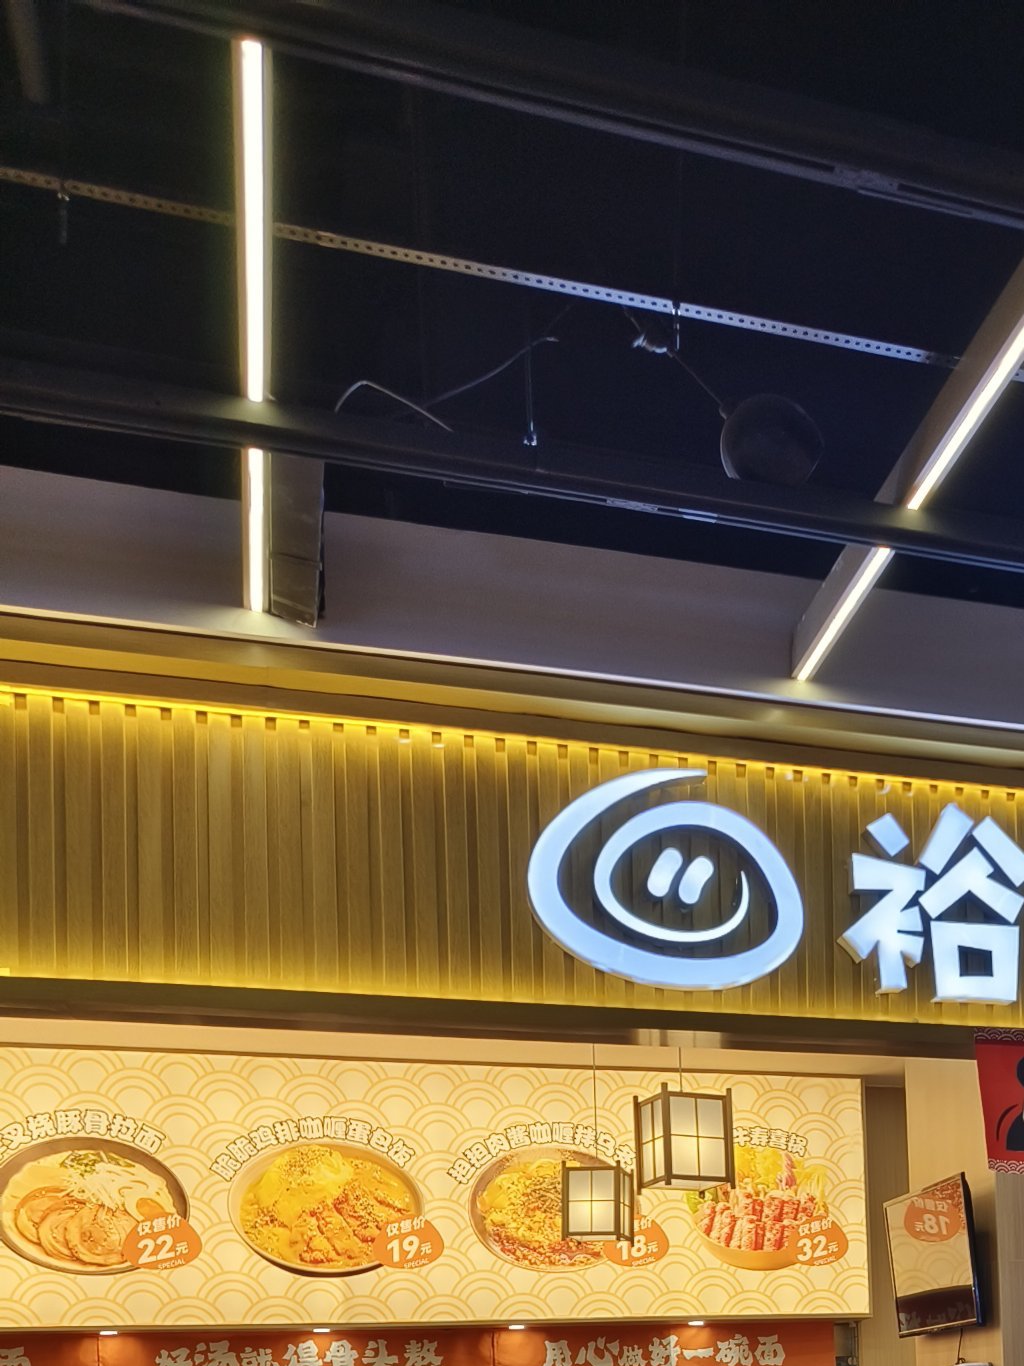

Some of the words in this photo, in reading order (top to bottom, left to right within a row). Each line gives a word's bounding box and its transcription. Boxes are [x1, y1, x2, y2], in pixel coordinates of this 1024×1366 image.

[0, 1108, 166, 1162] 叉烧豚骨拉面
[210, 1116, 416, 1182] 脆脆鸡排咖喱蛋包饭
[138, 1215, 182, 1236] 仅售价
[386, 1216, 427, 1237] 仅售价
[798, 1217, 833, 1236] 仅售价
[138, 1234, 189, 1265] 22元
[386, 1235, 432, 1263] 19元
[616, 1235, 658, 1261] 18元
[796, 1235, 839, 1262] 32元
[158, 1259, 186, 1270] SPECIAL
[404, 1258, 429, 1269] SPECIAL
